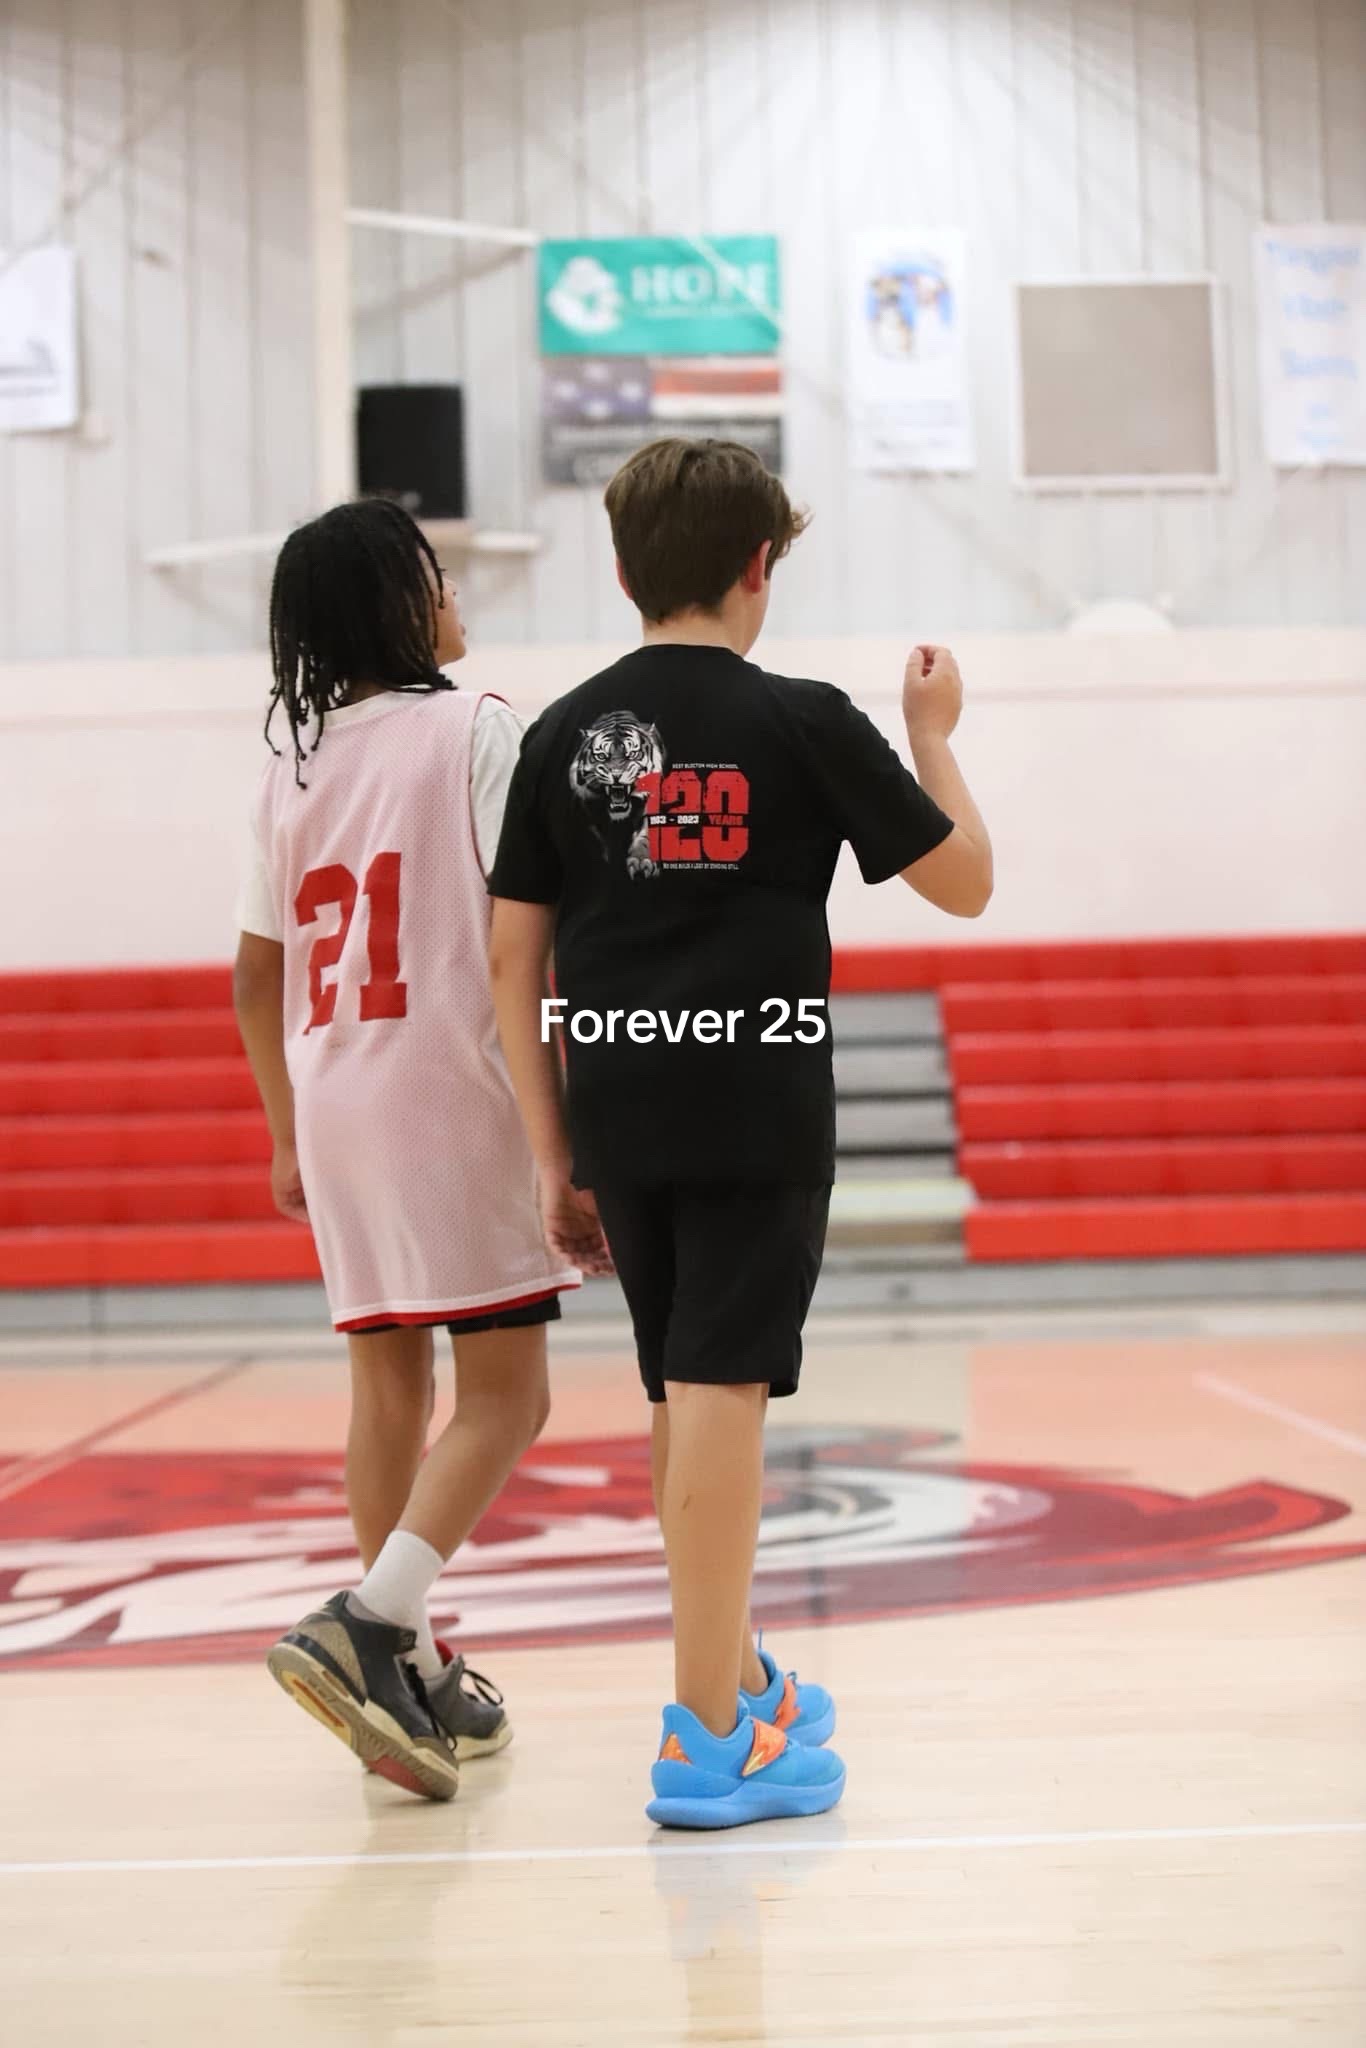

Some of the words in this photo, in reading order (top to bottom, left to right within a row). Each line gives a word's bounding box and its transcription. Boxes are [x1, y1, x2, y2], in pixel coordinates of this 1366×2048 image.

[630, 263, 769, 303] HOPE
[635, 770, 750, 862] 120
[677, 814, 700, 825] 2023
[708, 814, 744, 825] YEARS
[294, 851, 408, 1036] 21
